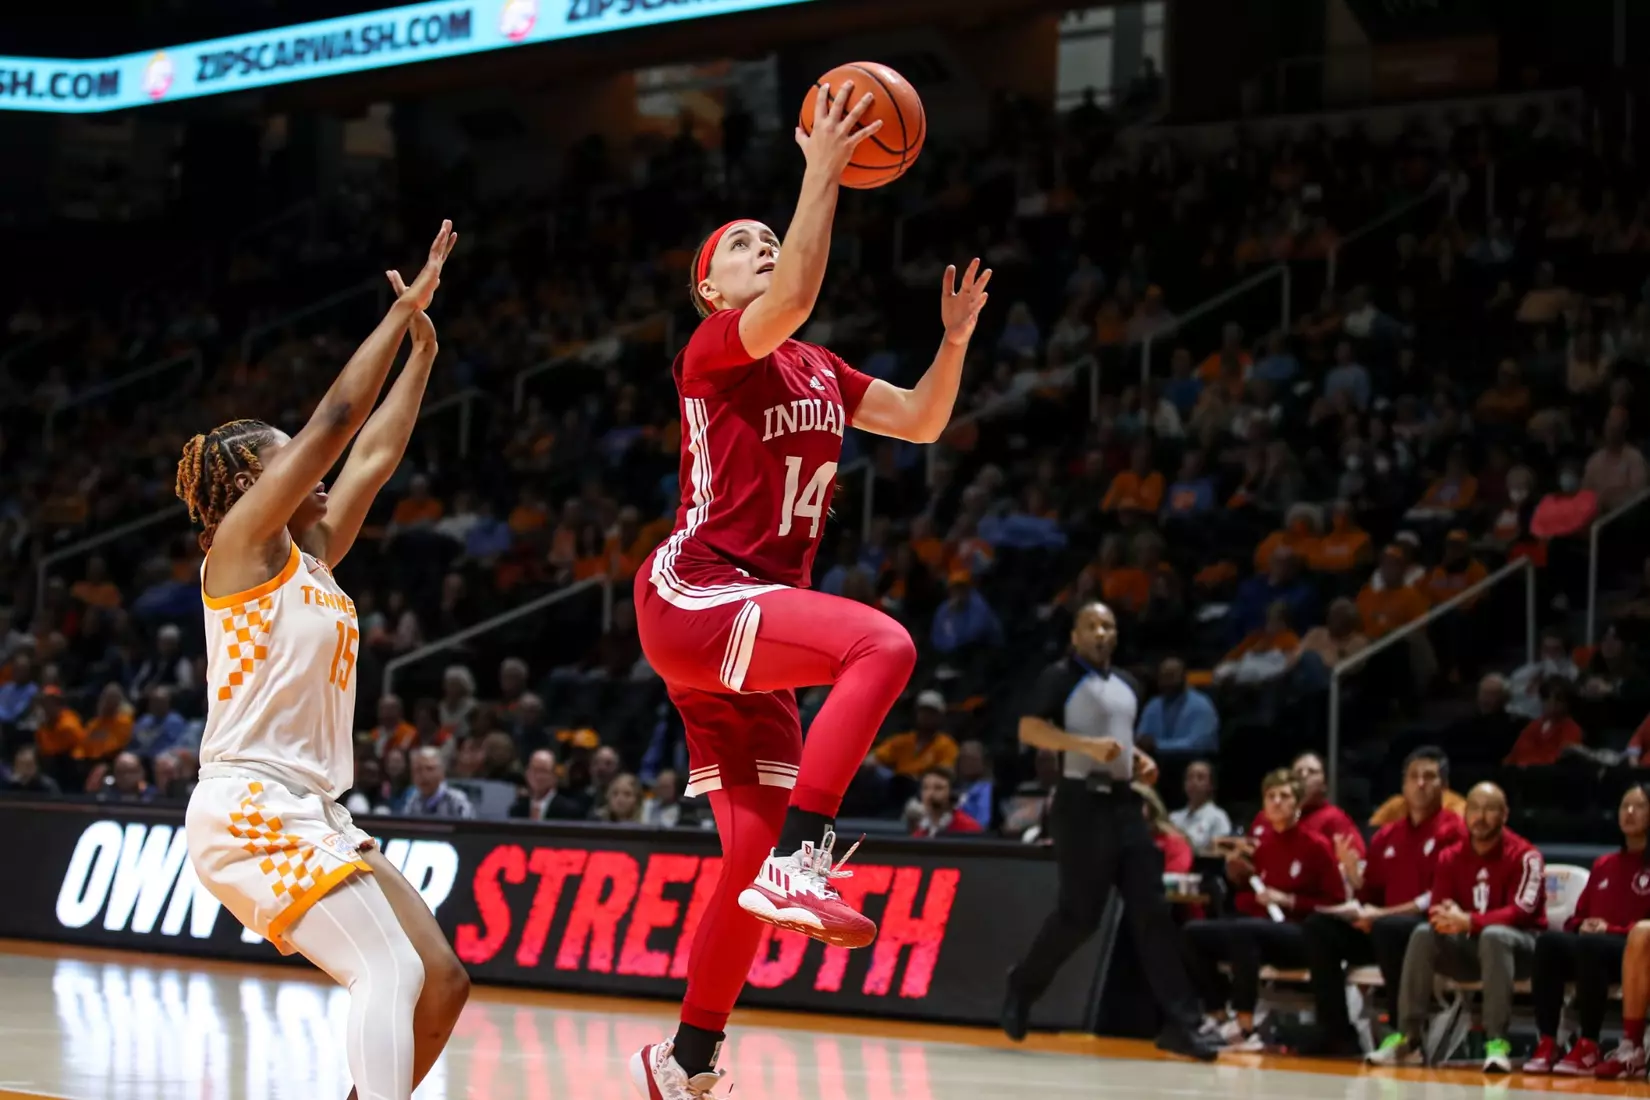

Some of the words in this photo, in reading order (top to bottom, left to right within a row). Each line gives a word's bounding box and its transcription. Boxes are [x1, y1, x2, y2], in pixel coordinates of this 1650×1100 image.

[196, 9, 472, 82] ZIPSCARWASH.COM
[778, 455, 838, 538] 14
[329, 620, 358, 692] 15
